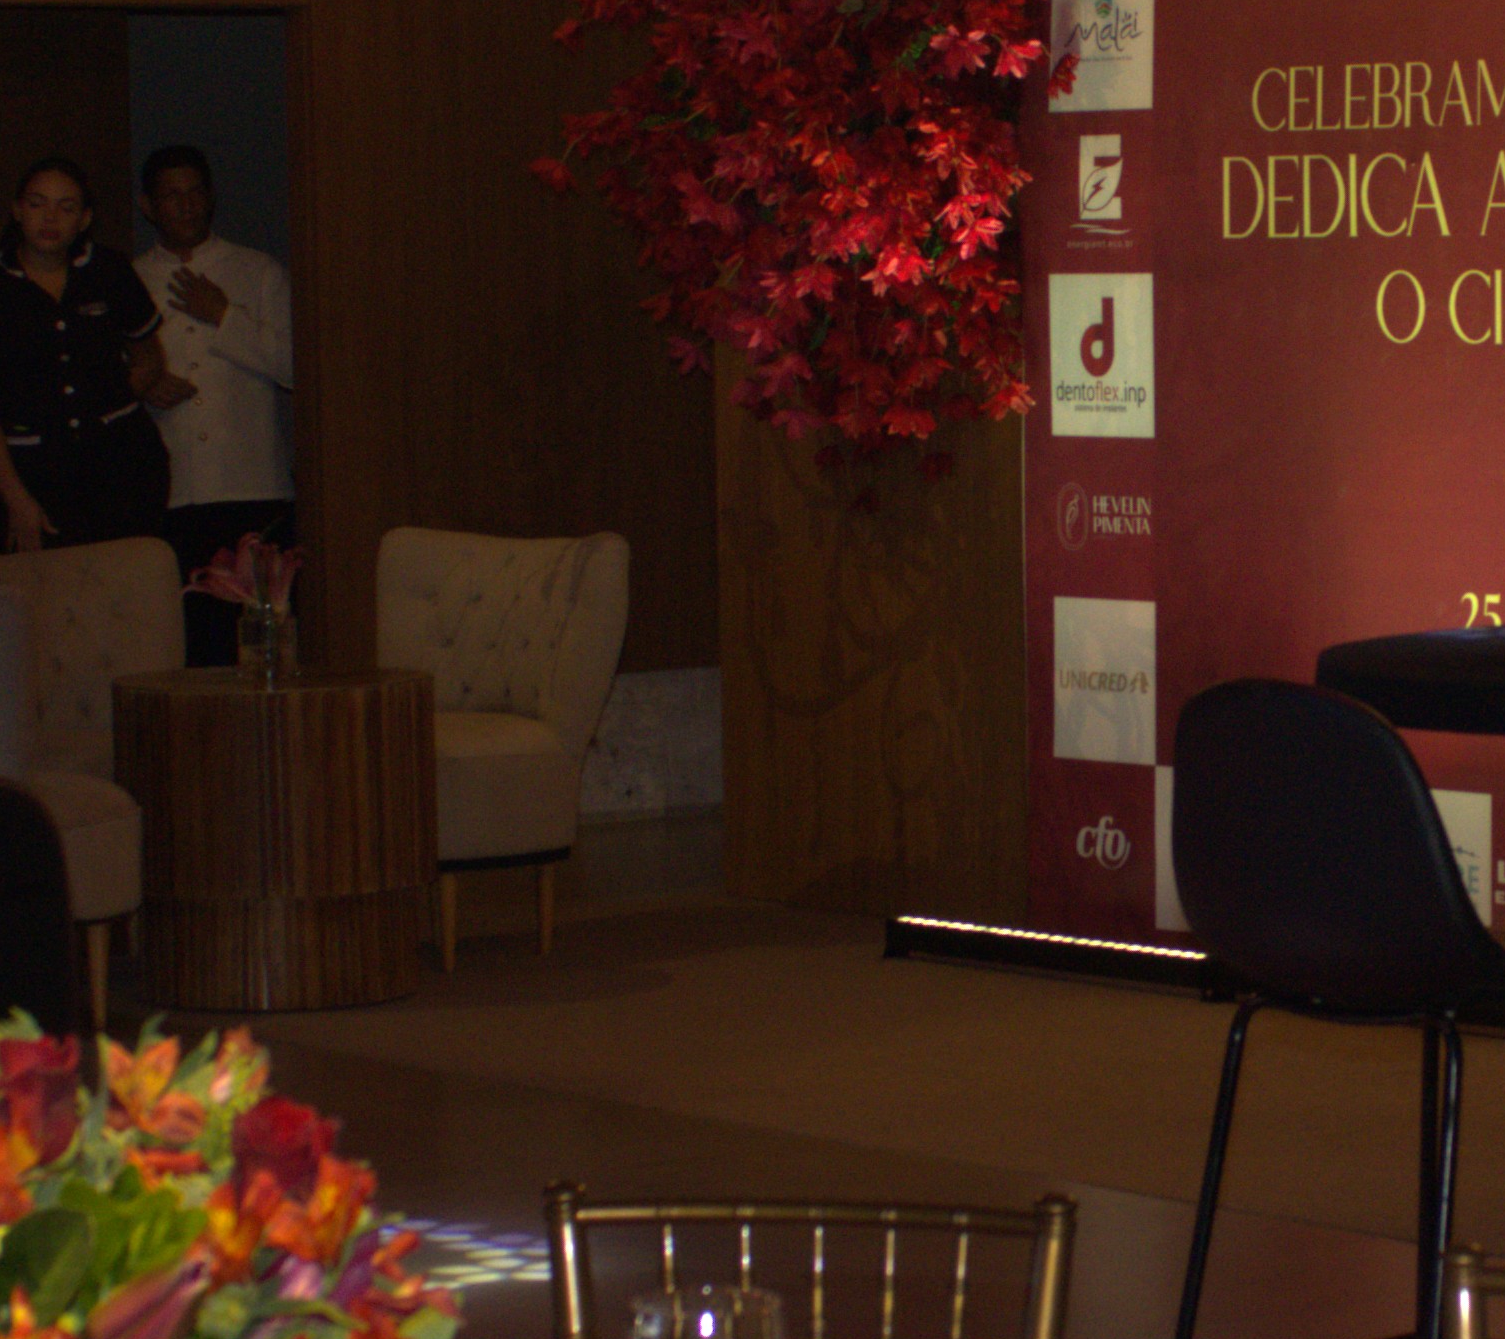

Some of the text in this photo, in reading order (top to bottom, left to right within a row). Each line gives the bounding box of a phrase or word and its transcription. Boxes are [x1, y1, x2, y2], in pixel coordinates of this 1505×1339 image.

[1222, 151, 1451, 239] DEDICA
[1376, 269, 1426, 344] O
[1093, 495, 1151, 516] HEVELIN
[1093, 516, 1151, 536] PIMENTA
[1461, 592, 1502, 629] 25
[1060, 671, 1127, 693] UNICRED
